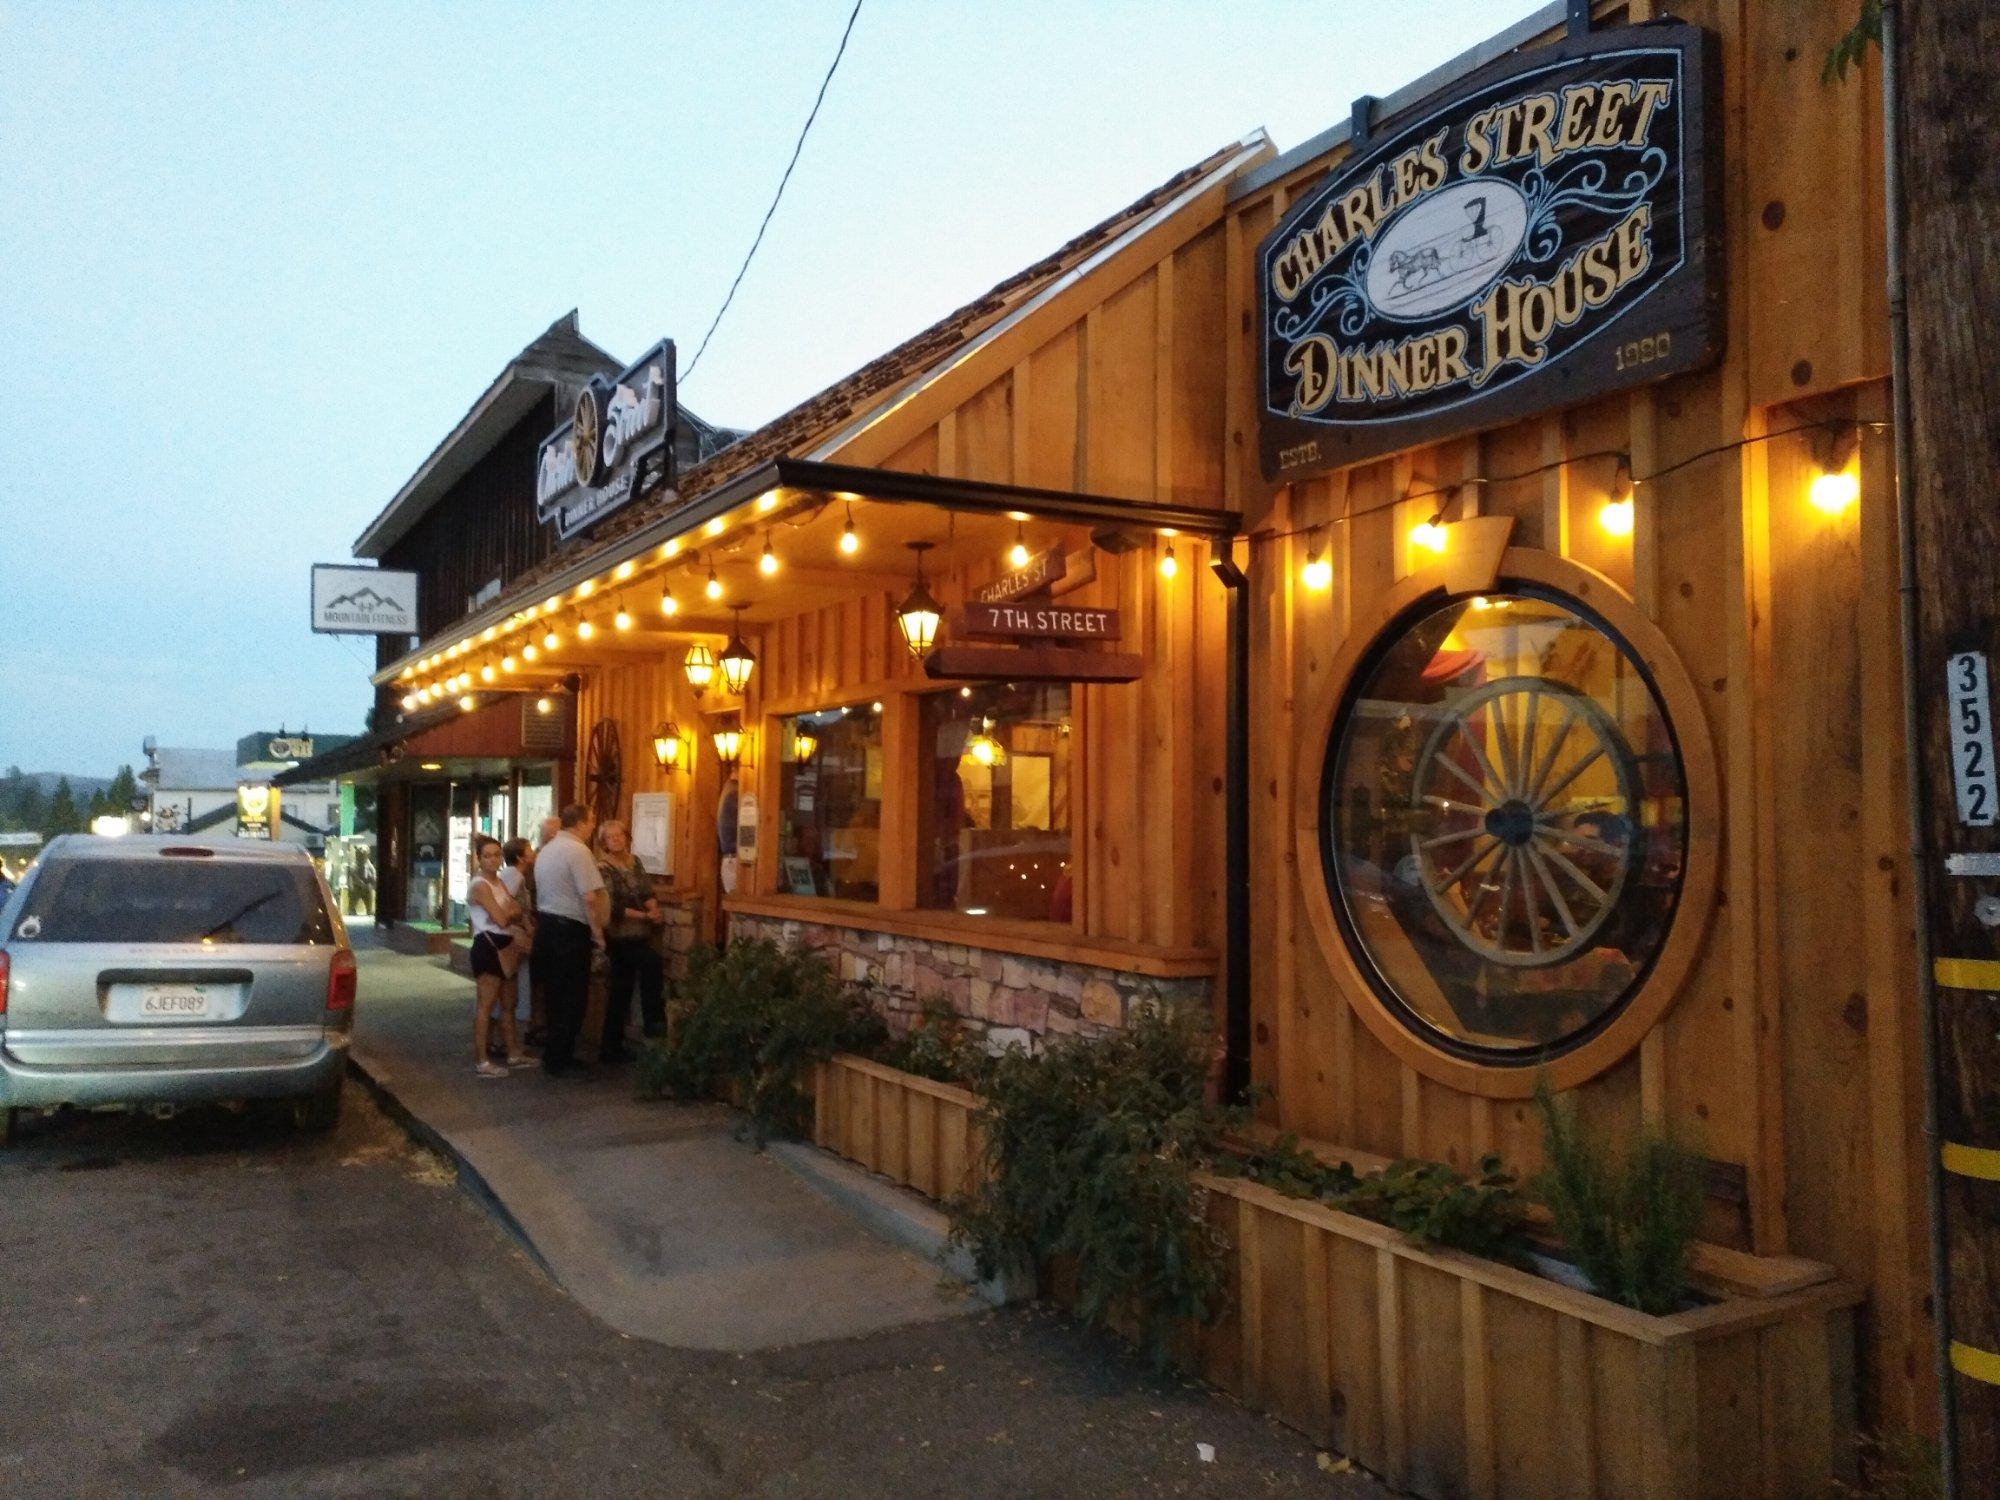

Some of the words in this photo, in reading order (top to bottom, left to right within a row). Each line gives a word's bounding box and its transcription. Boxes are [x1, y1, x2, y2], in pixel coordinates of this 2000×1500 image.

[1271, 127, 1449, 302] CHARLES
[1459, 79, 1673, 176] STREET
[1461, 196, 1488, 241] 7
[1285, 326, 1476, 418] DINNER
[1470, 201, 1653, 388] HOUSE
[981, 573, 1029, 603] CHARLES
[1034, 558, 1048, 582] ST
[1037, 611, 1107, 632] STREET
[1958, 655, 1989, 821] 3522
